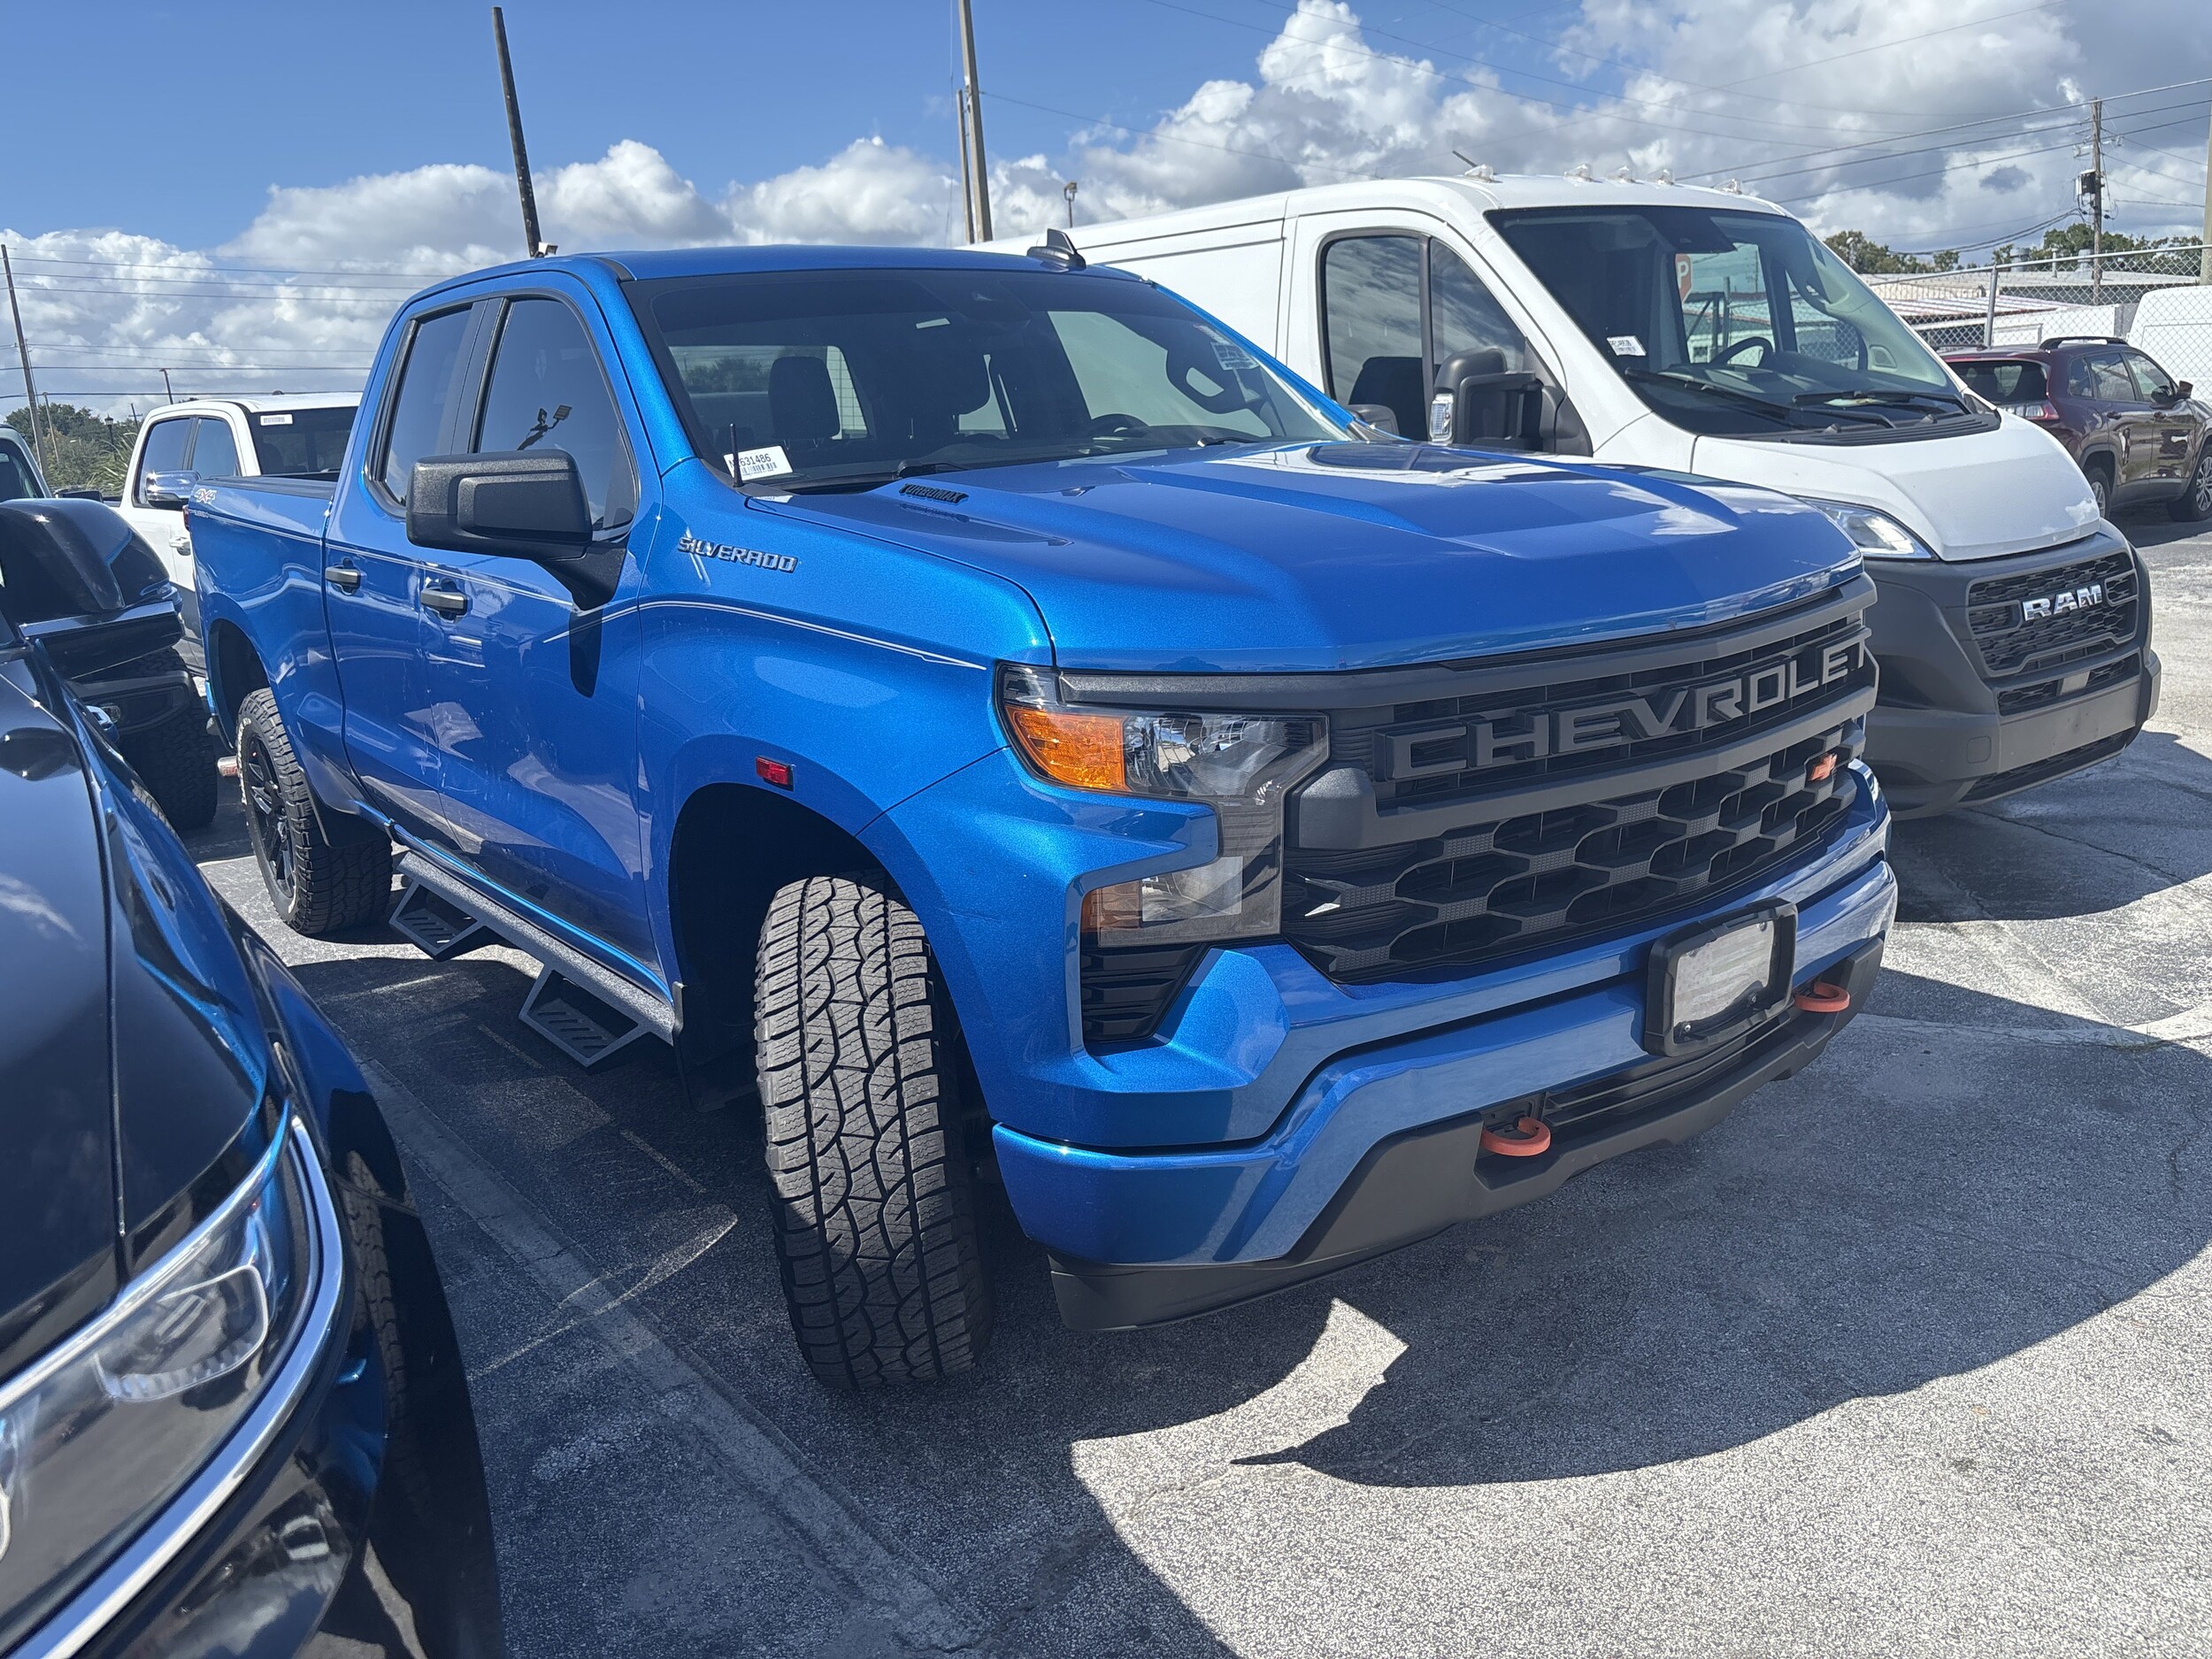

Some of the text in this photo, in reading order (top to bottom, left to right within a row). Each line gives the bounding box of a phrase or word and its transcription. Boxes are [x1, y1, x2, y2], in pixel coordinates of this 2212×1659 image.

[728, 453, 772, 469] N631486
[899, 483, 968, 504] TURBOMAX
[678, 536, 798, 573] SILVERADO
[2023, 584, 2103, 621] RAM
[1379, 626, 1872, 781] CHEVROLET
